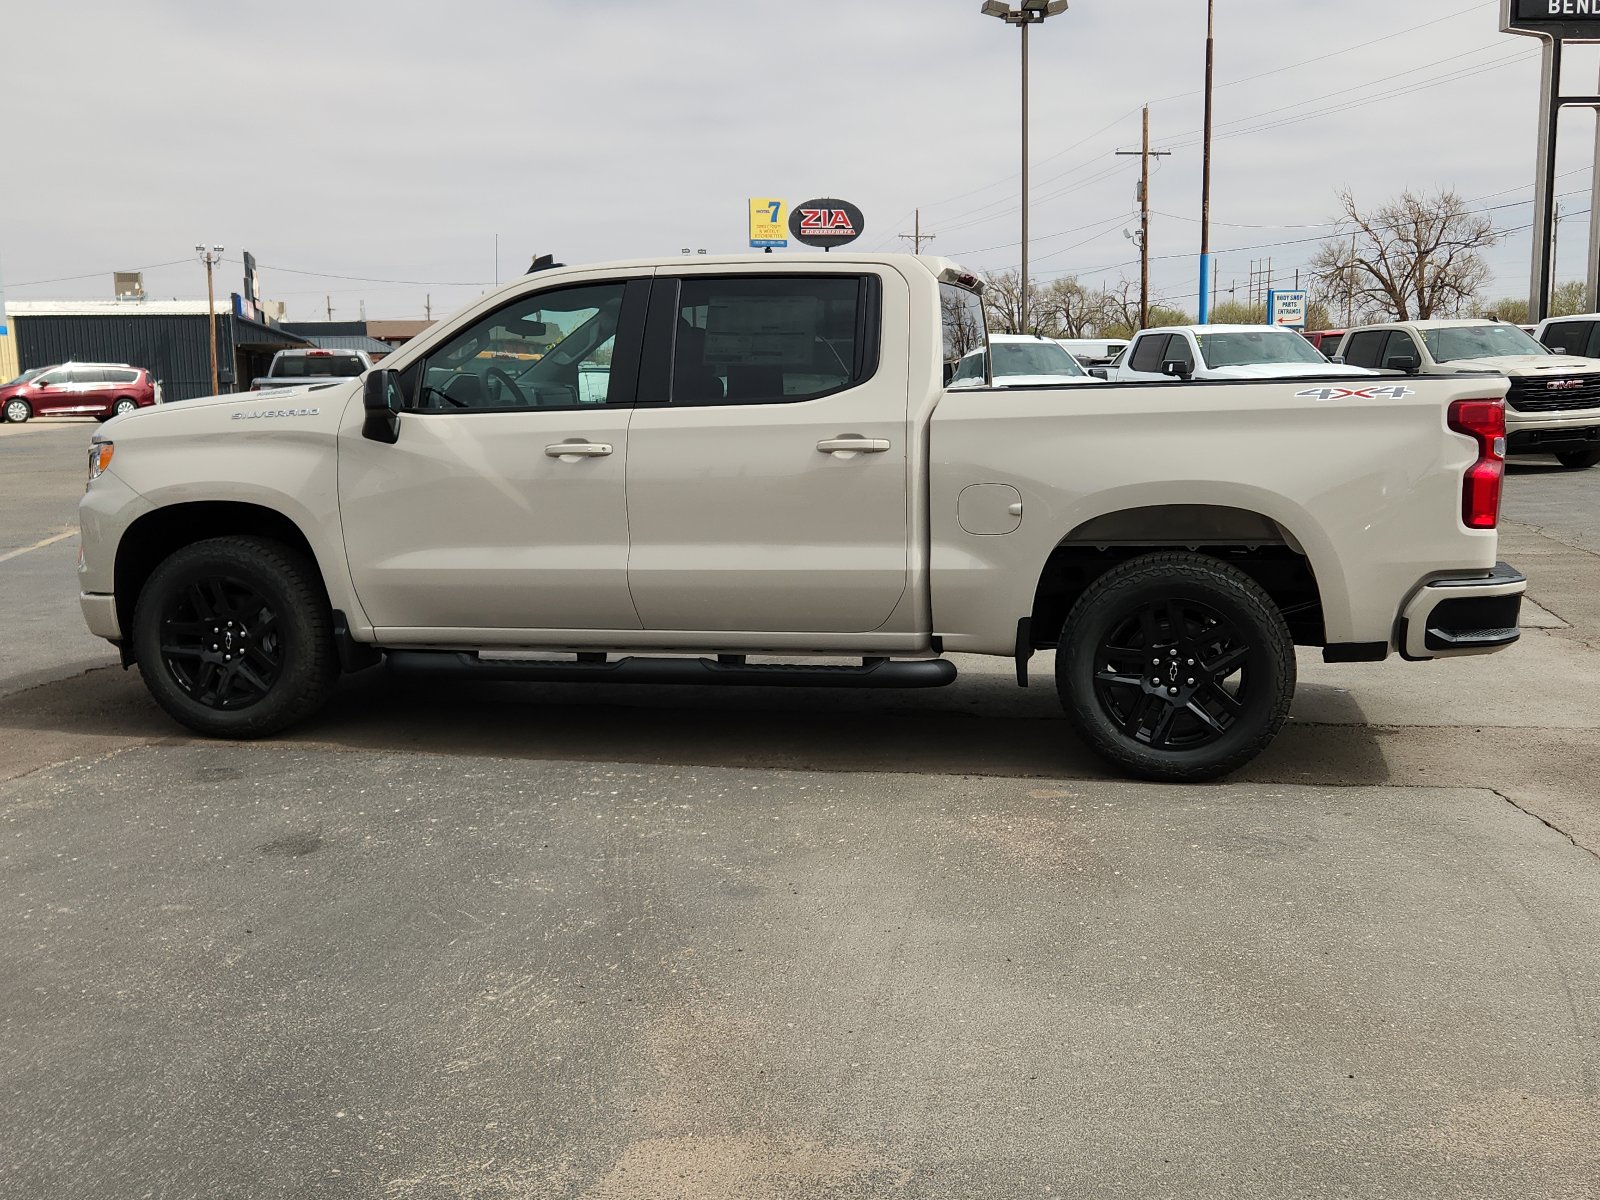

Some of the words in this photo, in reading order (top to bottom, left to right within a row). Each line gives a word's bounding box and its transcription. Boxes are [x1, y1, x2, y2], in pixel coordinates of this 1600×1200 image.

[768, 201, 781, 223] 7
[800, 209, 852, 228] ZIA
[1546, 379, 1584, 390] GMC
[232, 408, 320, 420] SILVERADO
